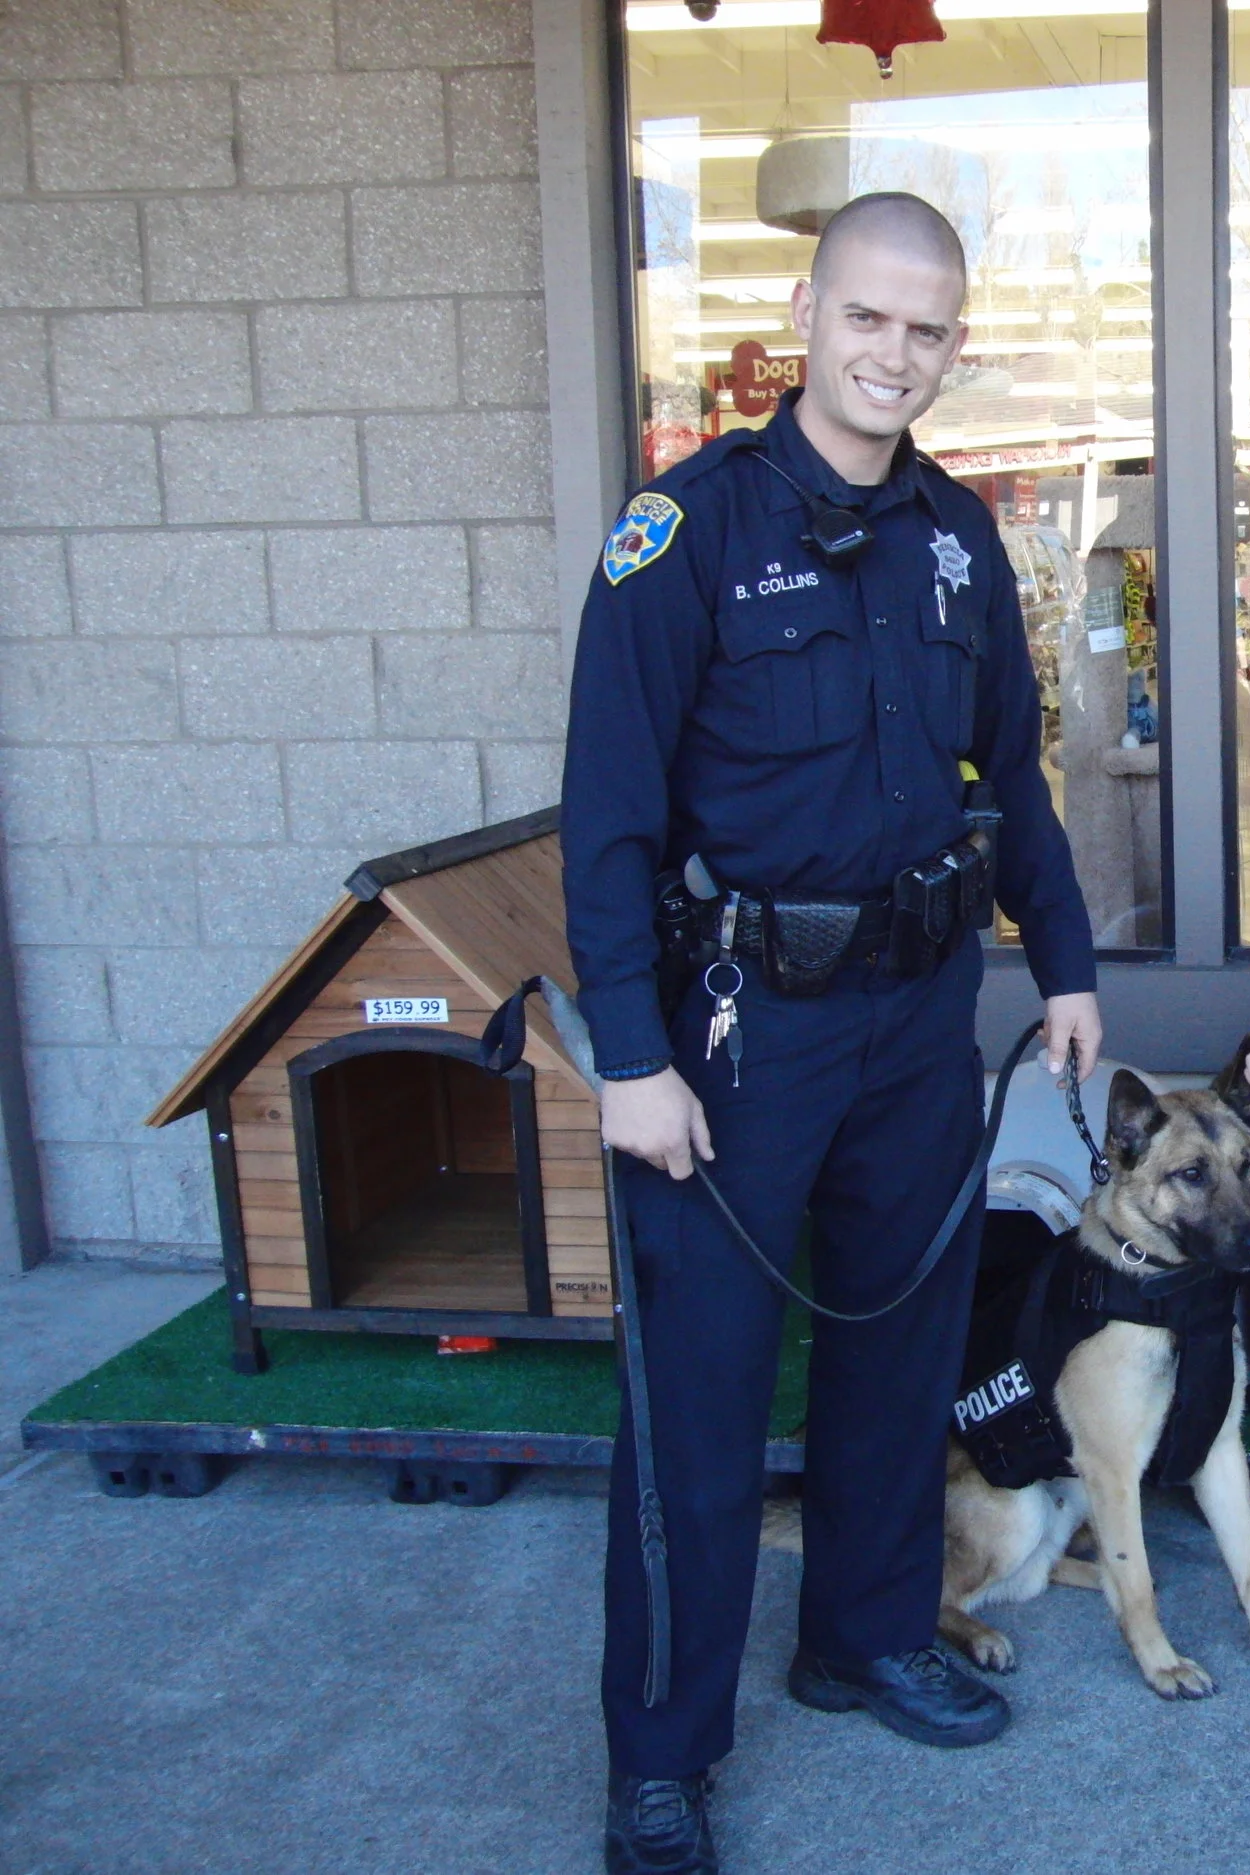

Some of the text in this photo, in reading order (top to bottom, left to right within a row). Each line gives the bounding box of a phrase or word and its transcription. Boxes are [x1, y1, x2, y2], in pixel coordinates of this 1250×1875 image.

[753, 359, 800, 387] Dog
[748, 389, 768, 400] Buy
[767, 562, 782, 574] K9
[735, 572, 819, 600] B. COLLINS
[373, 1000, 440, 1016] $159.99
[954, 1363, 1031, 1432] POLICE
